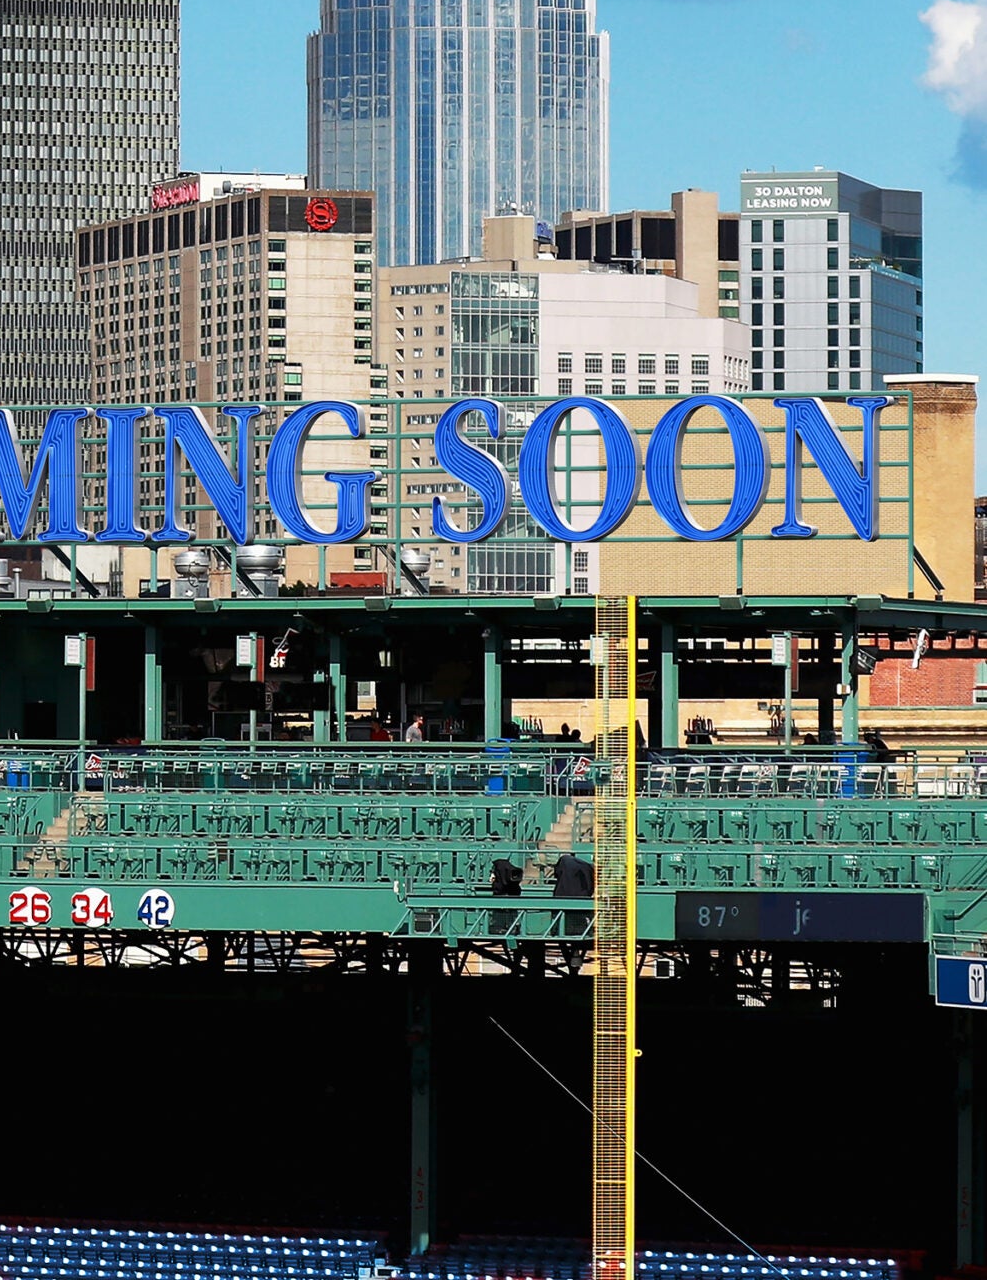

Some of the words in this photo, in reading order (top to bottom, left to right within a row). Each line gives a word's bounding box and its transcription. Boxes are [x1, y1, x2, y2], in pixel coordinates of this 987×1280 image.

[755, 187, 771, 196] 30
[774, 186, 823, 196] DALTON
[746, 198, 798, 208] LEASING
[801, 197, 832, 208] NOW
[432, 394, 895, 543] SOON
[10, 893, 50, 922] 26
[72, 894, 112, 924] 34
[137, 896, 168, 925] 42
[698, 906, 739, 927] 87°
